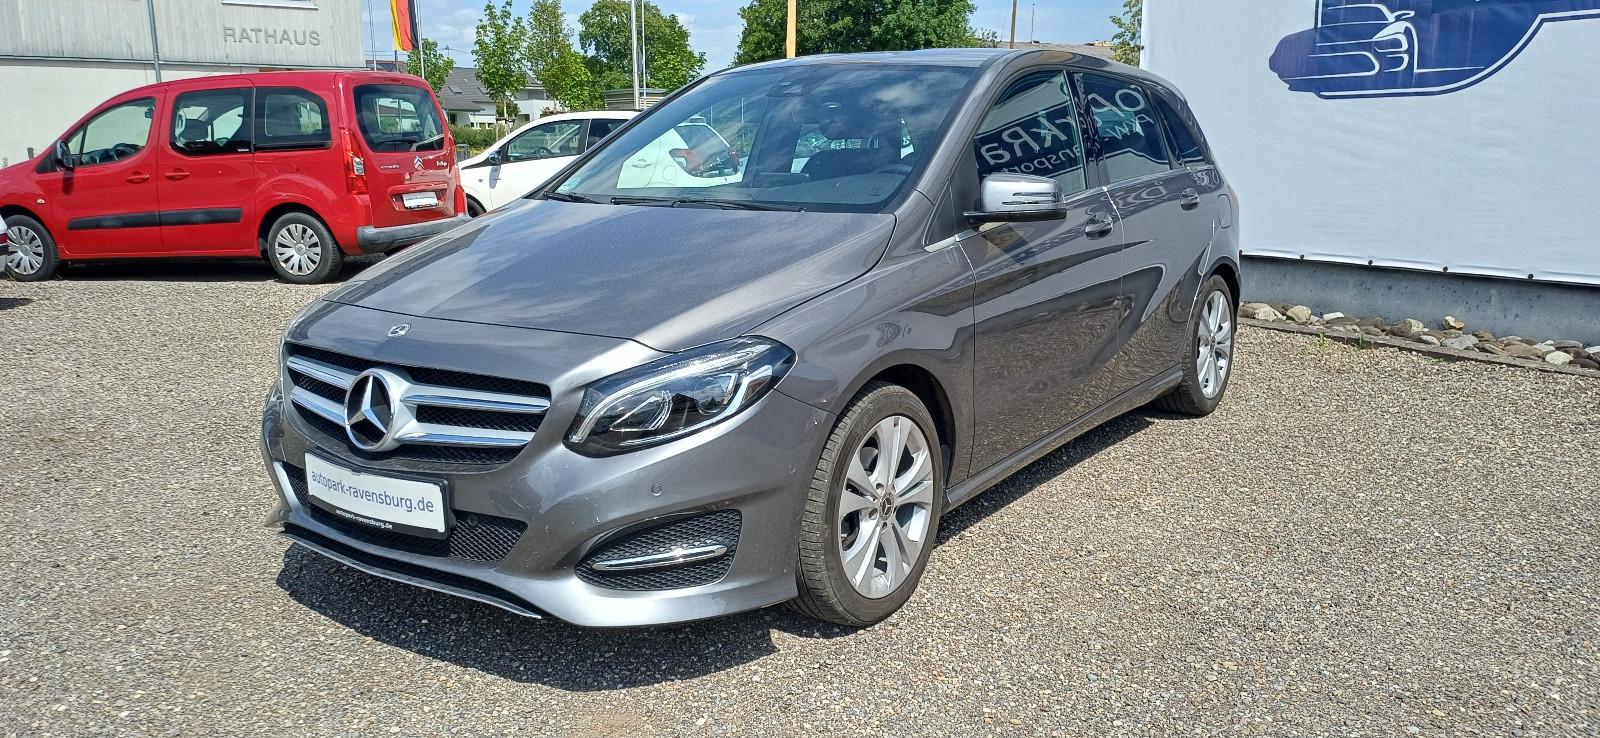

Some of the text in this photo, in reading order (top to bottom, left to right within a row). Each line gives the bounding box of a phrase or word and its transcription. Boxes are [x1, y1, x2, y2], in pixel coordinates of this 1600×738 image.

[223, 25, 321, 46] RATHAUS
[311, 470, 434, 513] autopark-ravensburg.de
[335, 508, 393, 530] autopark-ravensburg.de
